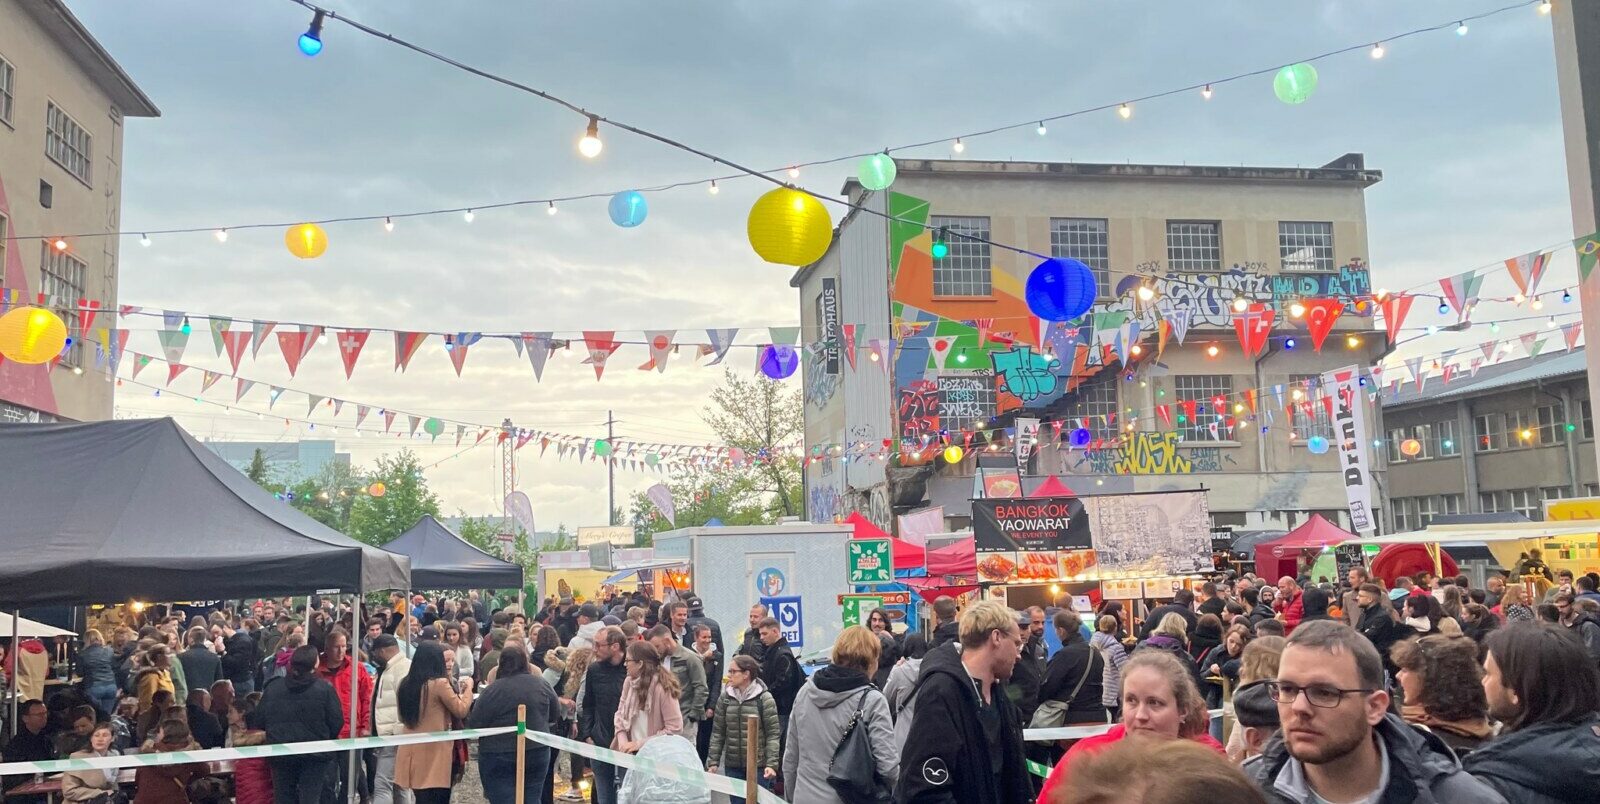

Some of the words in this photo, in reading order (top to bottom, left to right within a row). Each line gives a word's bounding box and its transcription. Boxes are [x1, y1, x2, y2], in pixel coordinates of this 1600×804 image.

[995, 504, 1070, 519] BANGKOK
[997, 518, 1071, 531] YAOWARAT
[1211, 532, 1231, 540] DWICH
[782, 631, 798, 641] PET
